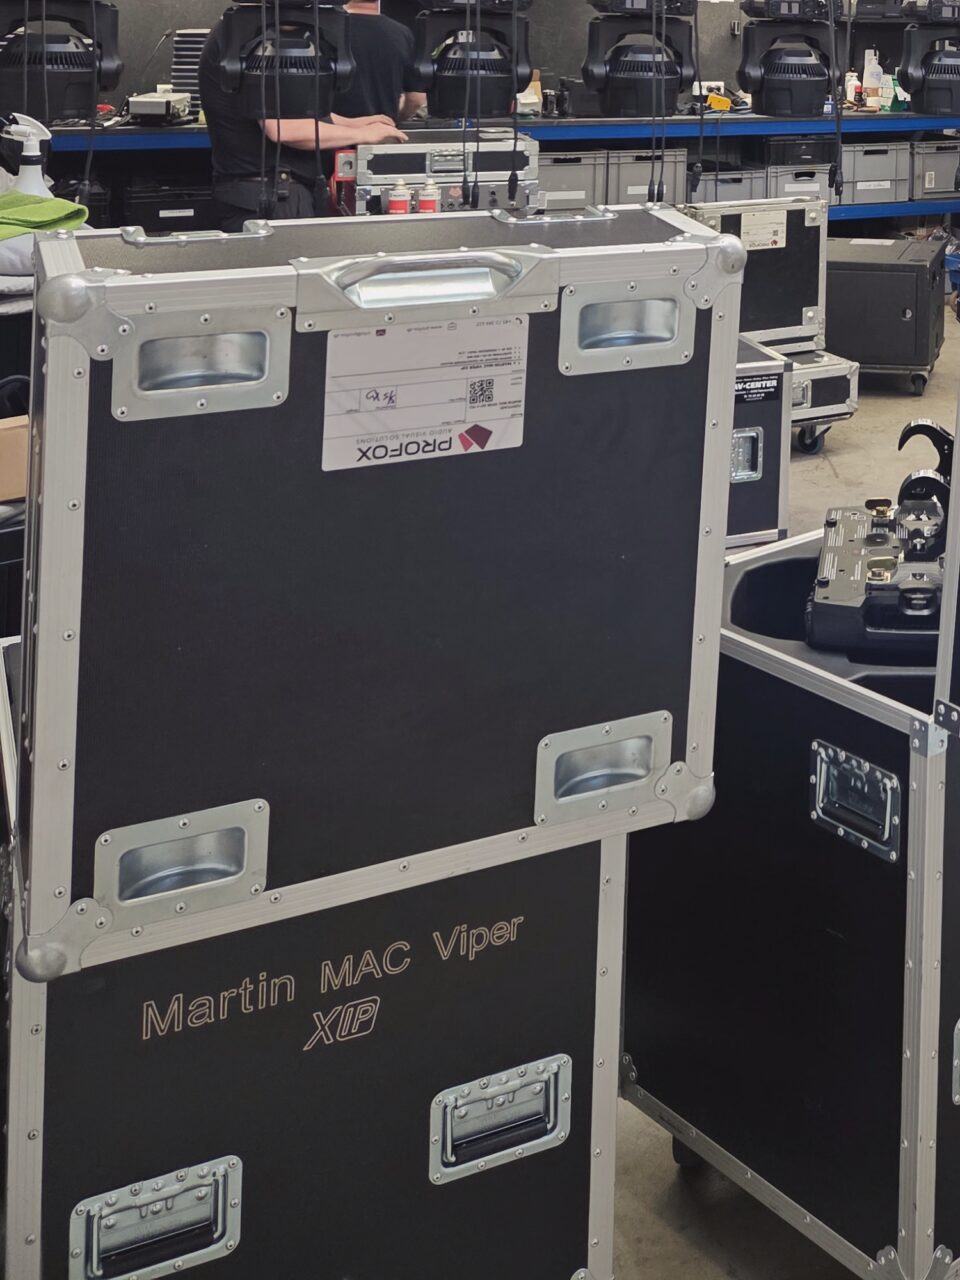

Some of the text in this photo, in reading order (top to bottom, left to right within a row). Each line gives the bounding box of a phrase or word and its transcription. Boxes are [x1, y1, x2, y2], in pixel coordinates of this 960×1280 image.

[356, 428, 453, 445] AUDIO VISUAL SOLUTIONS
[356, 437, 452, 462] PROFOX
[142, 915, 525, 1041] Martin MAC Viper
